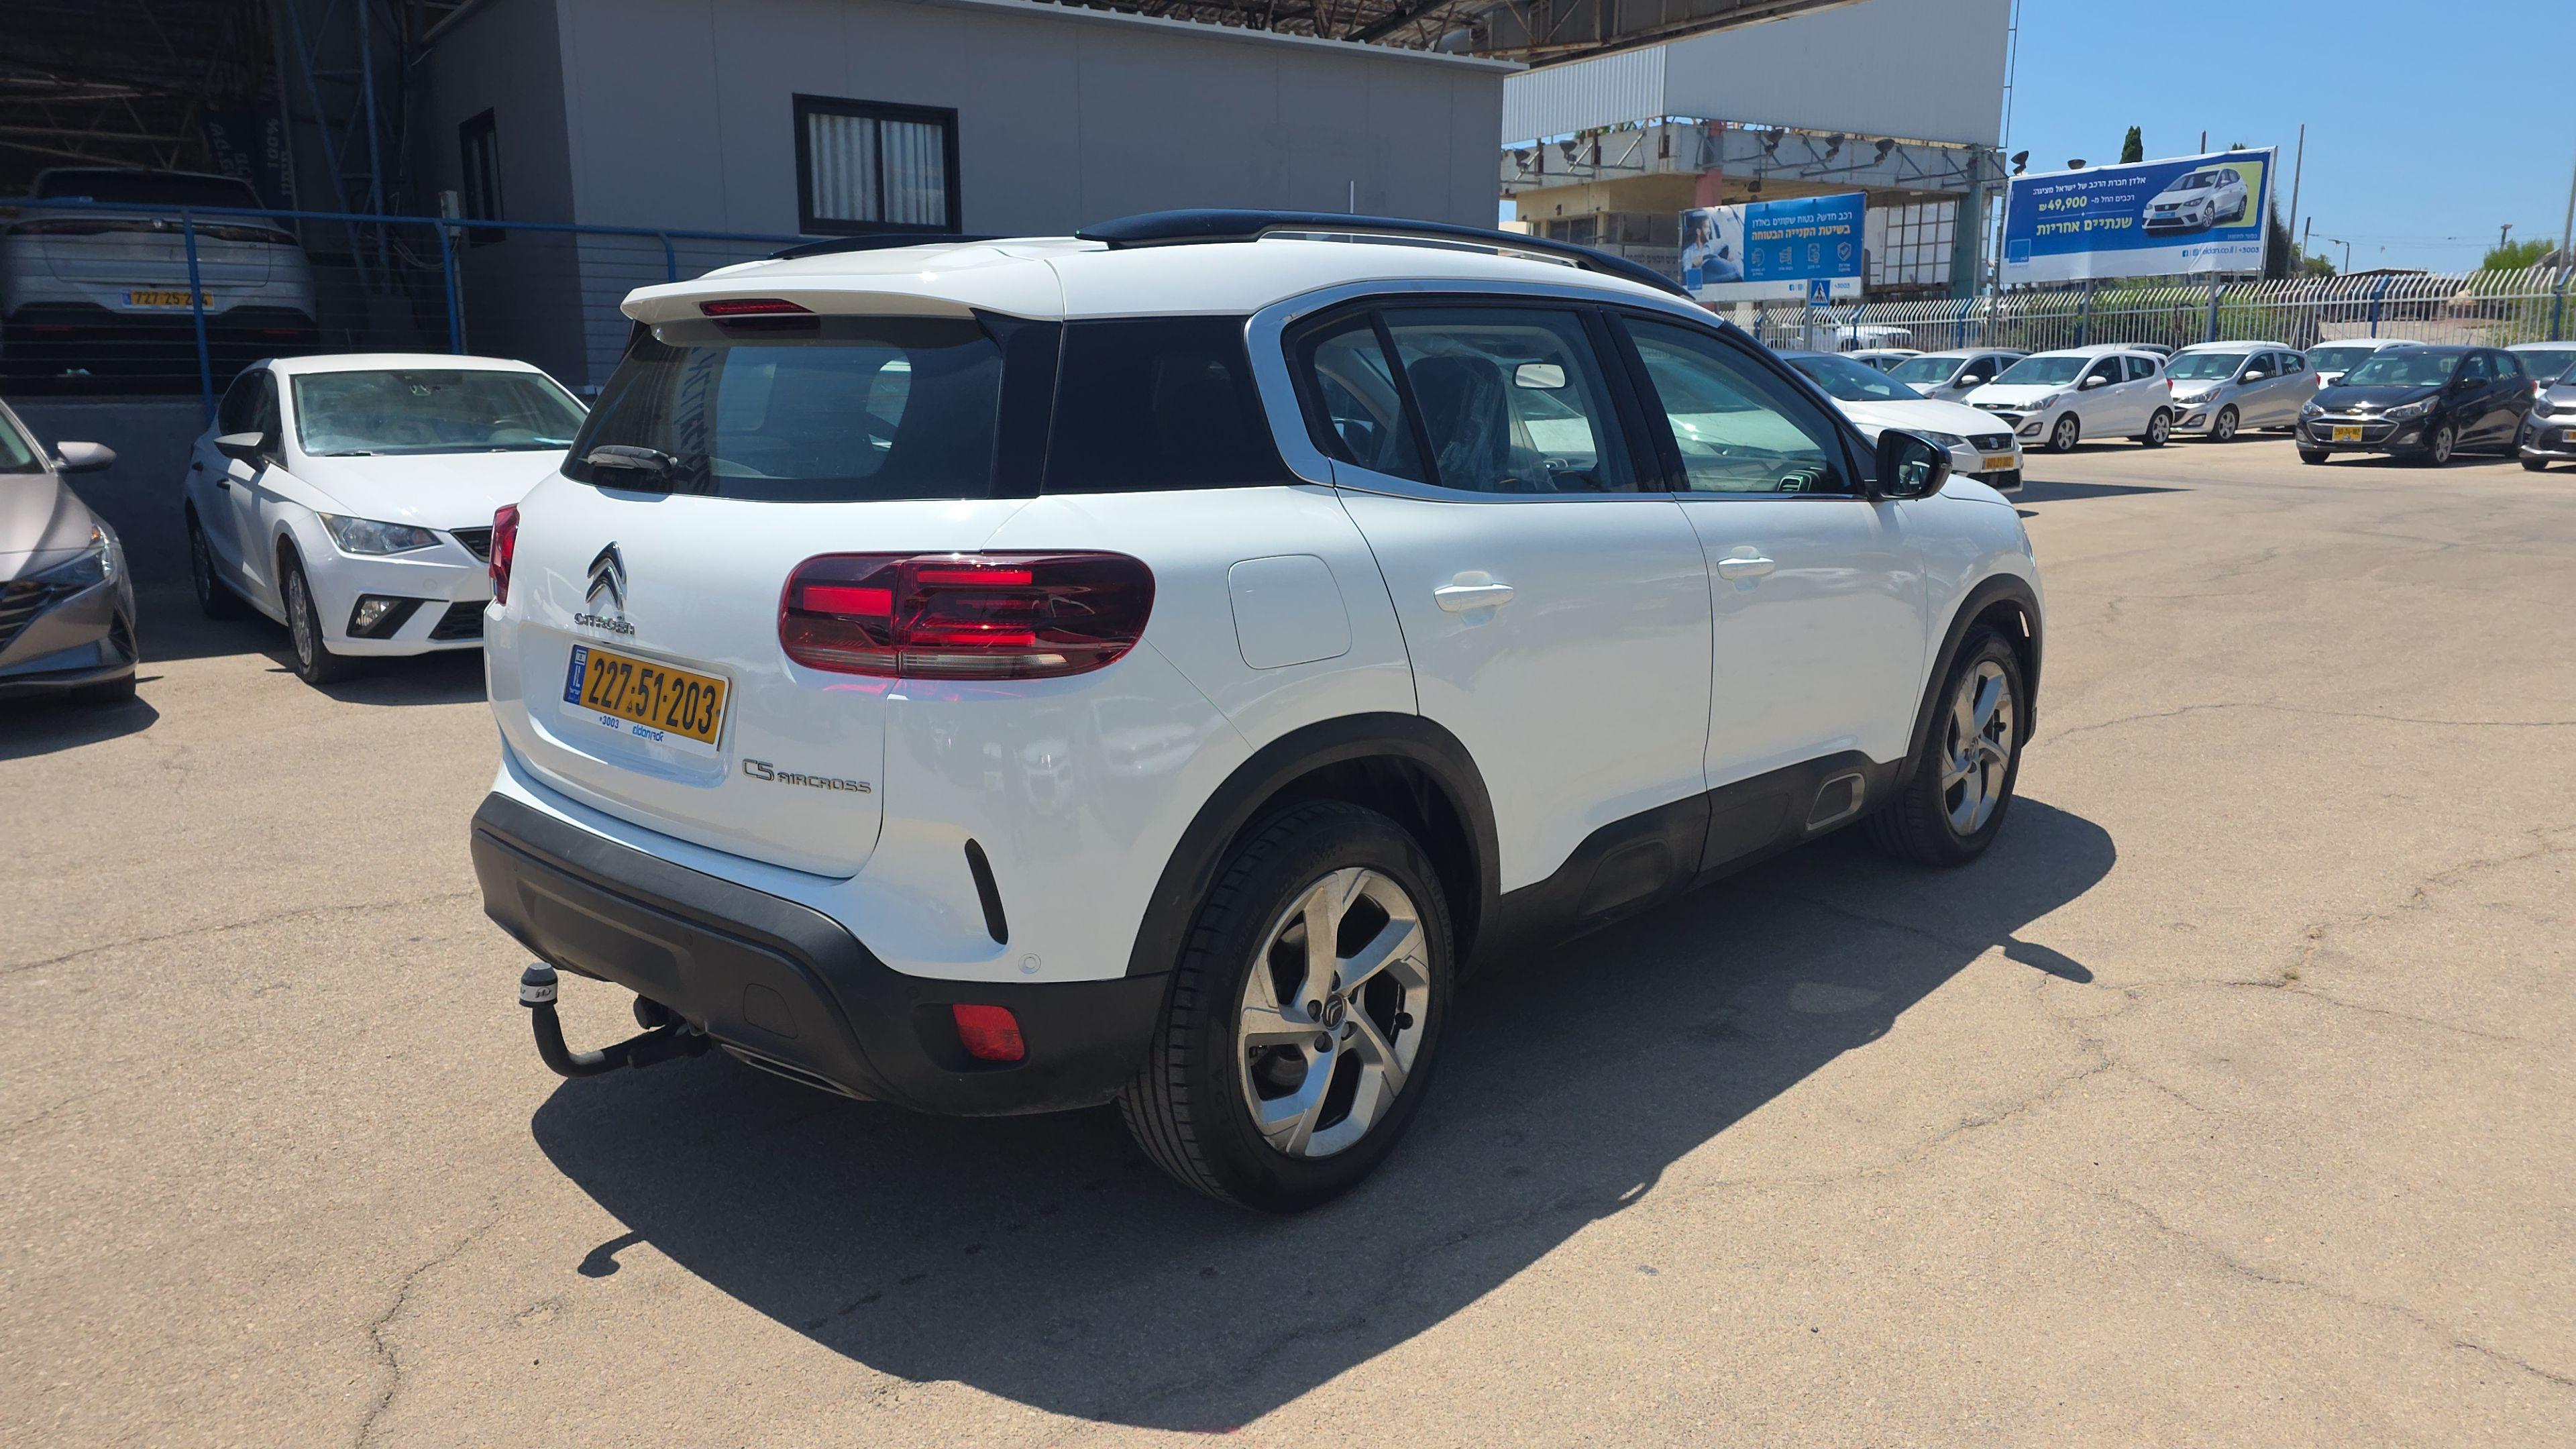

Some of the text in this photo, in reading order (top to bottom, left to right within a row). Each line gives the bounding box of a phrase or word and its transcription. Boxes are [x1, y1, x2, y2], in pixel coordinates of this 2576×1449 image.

[266, 118, 279, 168] 100%
[2078, 182, 2088, 190] של
[2088, 180, 2106, 189] הרכב
[2108, 178, 2127, 187] חברת
[2129, 176, 2147, 187] אלדן
[2055, 184, 2076, 193] ישראל
[2101, 195, 2114, 203] החל
[2115, 195, 2135, 203] רכבים
[1797, 215, 1814, 224] בטוח
[1838, 211, 1853, 221] רכב
[1752, 219, 1771, 228] באלדן
[2036, 216, 2133, 236] שנתיים אחריות
[1752, 224, 1851, 241] בשיטת הקנייה הבטוחה
[741, 758, 872, 794] C5 AIRCROSS
